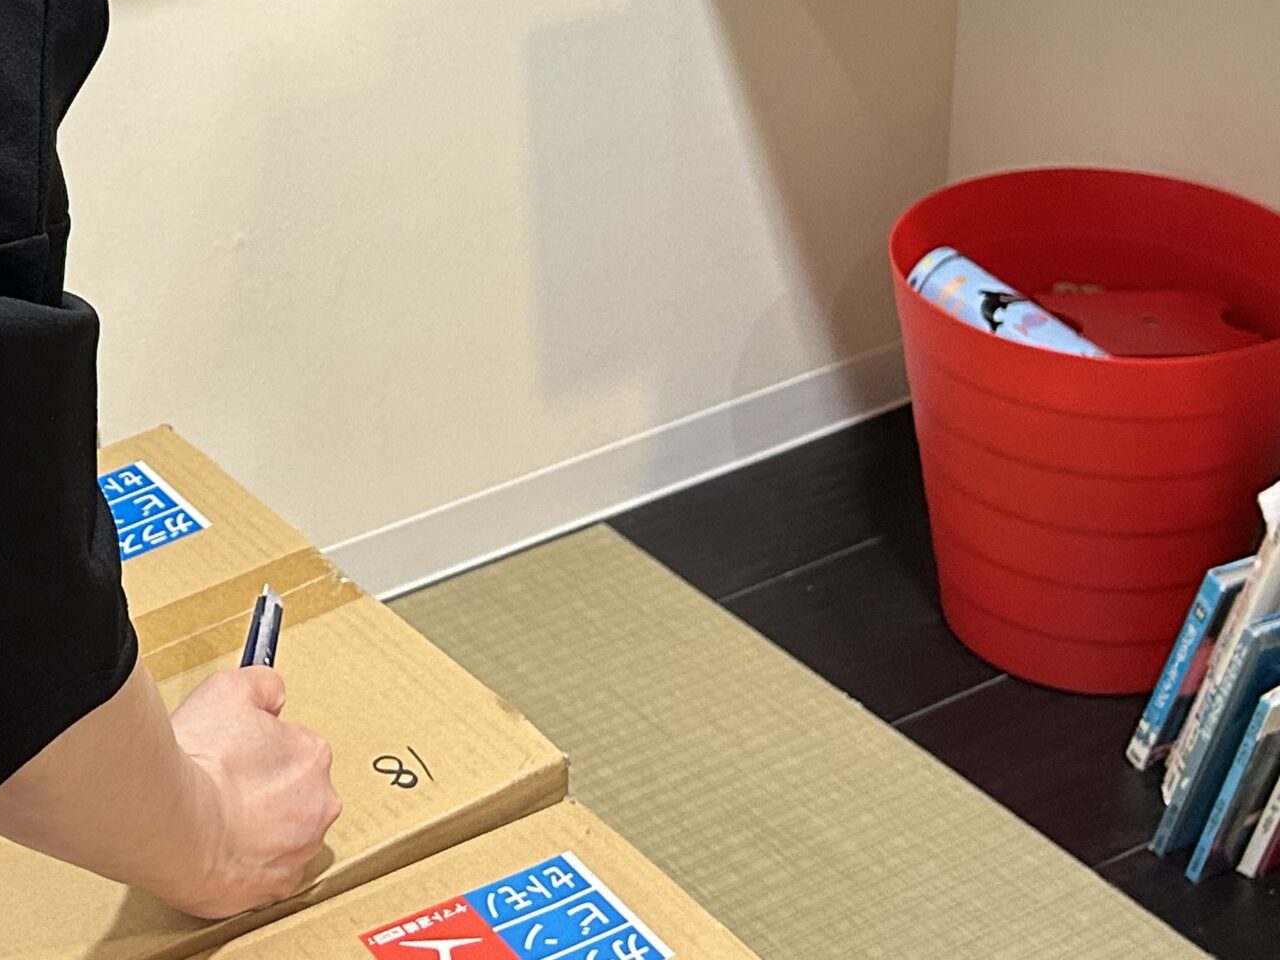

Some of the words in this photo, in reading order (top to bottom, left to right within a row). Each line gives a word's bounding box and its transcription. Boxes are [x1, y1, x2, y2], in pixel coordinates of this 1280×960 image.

[101, 470, 144, 498] セト
[119, 512, 194, 554] ガラス
[486, 865, 576, 919] セトモノ
[523, 901, 610, 951] ビン
